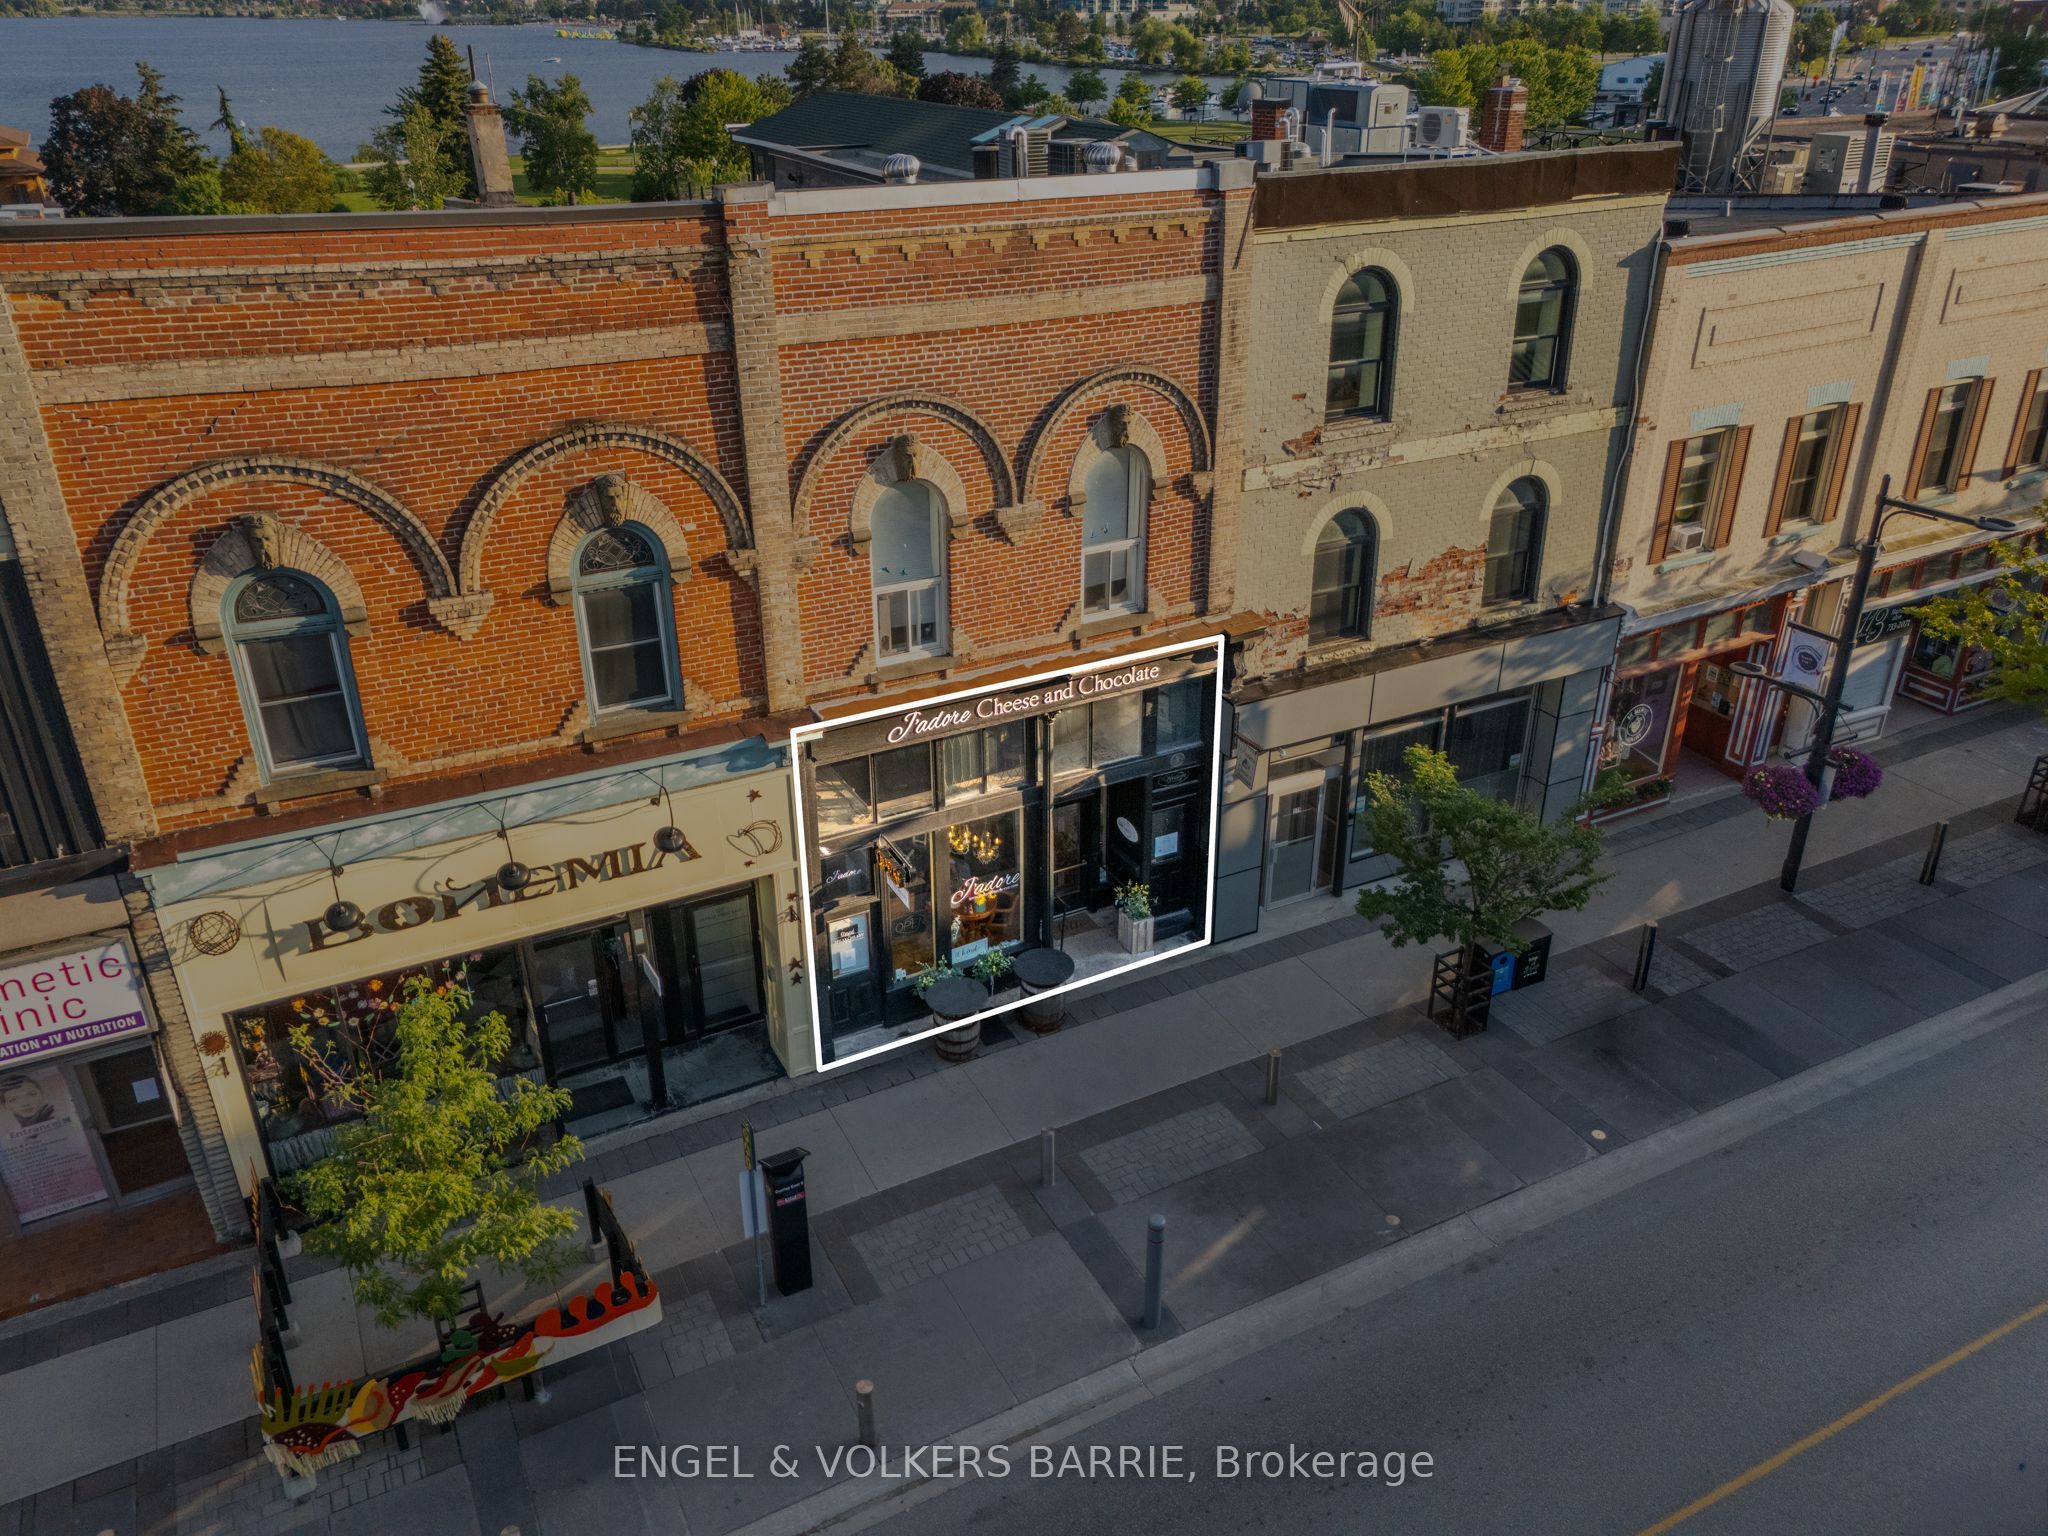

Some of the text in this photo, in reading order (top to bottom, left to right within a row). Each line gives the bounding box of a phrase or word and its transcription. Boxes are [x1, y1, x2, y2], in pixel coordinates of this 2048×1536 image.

[976, 692, 1040, 719] Cheese
[1044, 681, 1075, 703] and
[1078, 663, 1160, 696] Chocolate
[950, 871, 1021, 905] J'adore
[65, 1015, 138, 1042] NUTRITION
